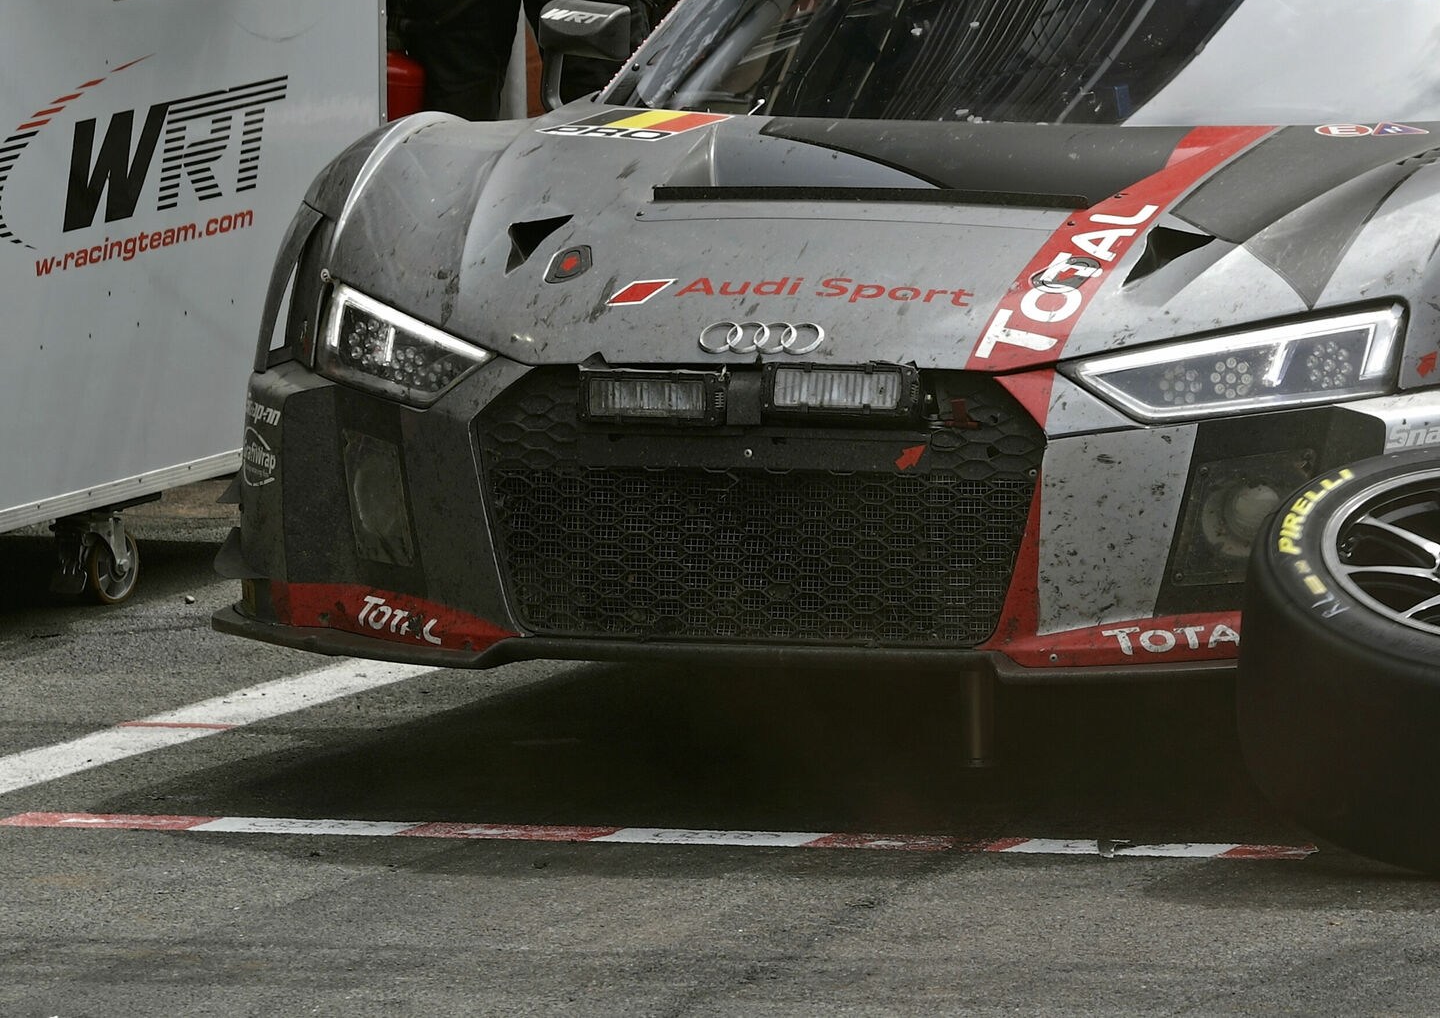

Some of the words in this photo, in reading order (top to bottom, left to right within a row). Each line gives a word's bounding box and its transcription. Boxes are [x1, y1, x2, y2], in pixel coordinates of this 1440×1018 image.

[541, 8, 609, 24] WRT
[62, 74, 289, 233] WRT
[543, 126, 673, 140] PRO
[35, 209, 254, 277] w-racingteam.com
[674, 277, 803, 298] Audi
[820, 278, 975, 308] Sport
[976, 203, 1160, 360] TOTAL
[1278, 468, 1356, 556] PIRELLI
[1101, 623, 1241, 656] TOTA
